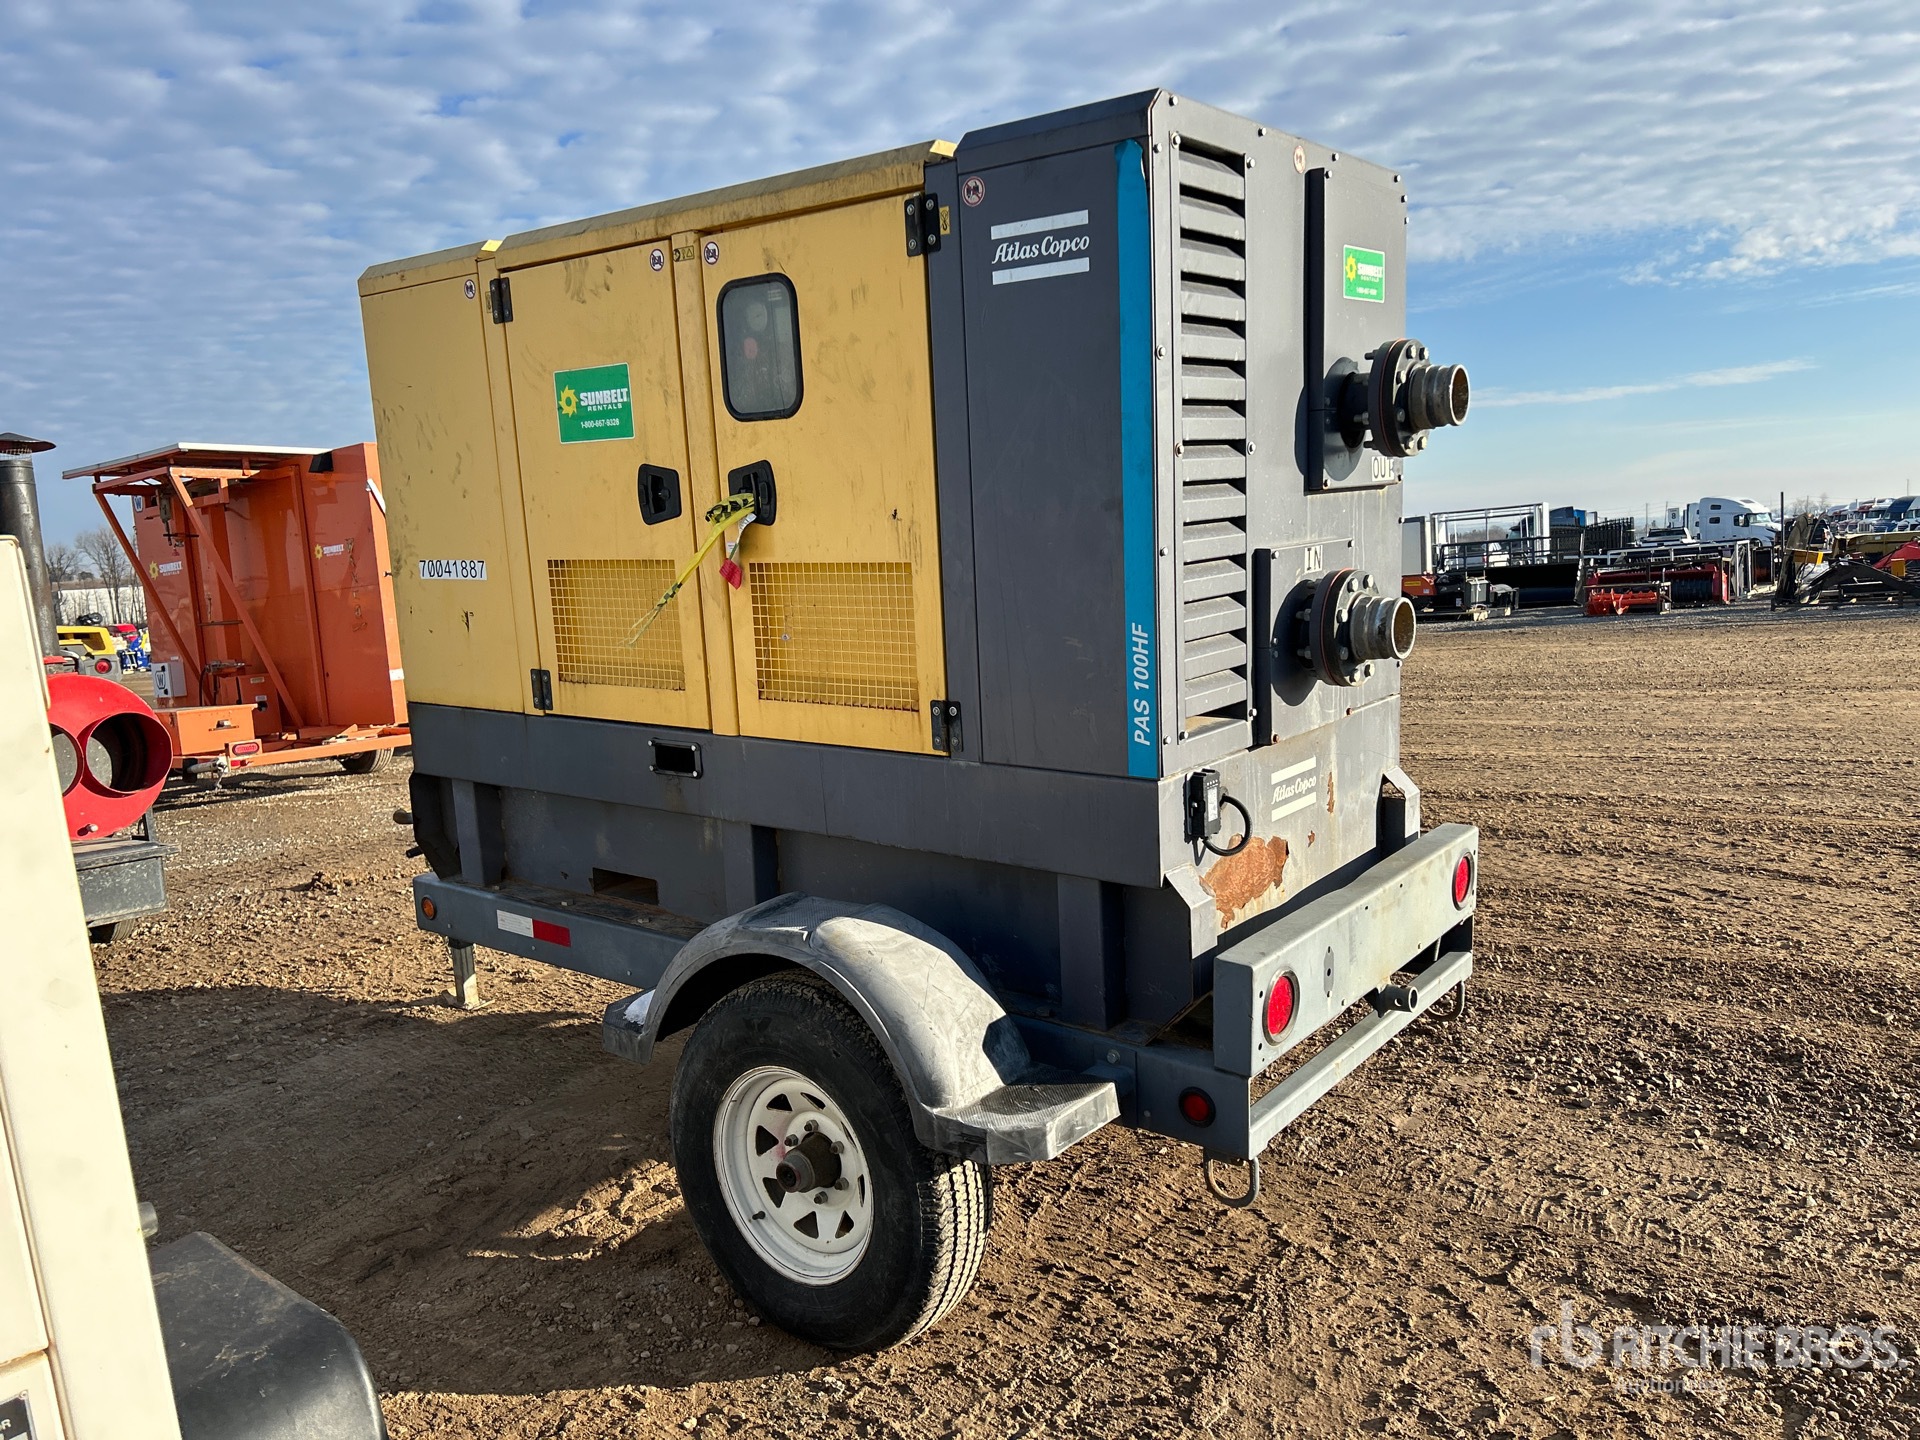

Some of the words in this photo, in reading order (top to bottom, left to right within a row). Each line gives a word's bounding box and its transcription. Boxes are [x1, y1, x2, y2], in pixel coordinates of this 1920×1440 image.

[991, 241, 1040, 264] Atlas
[1041, 235, 1090, 258] Copco
[579, 387, 628, 406] SUNBELT
[587, 402, 623, 411] RENTALS
[419, 559, 485, 579] 70041887
[1306, 545, 1322, 571] IN
[1131, 622, 1150, 690] 100HF
[1133, 698, 1151, 746] PAS
[1271, 782, 1295, 805] Atlas
[1294, 775, 1317, 794] Copco
